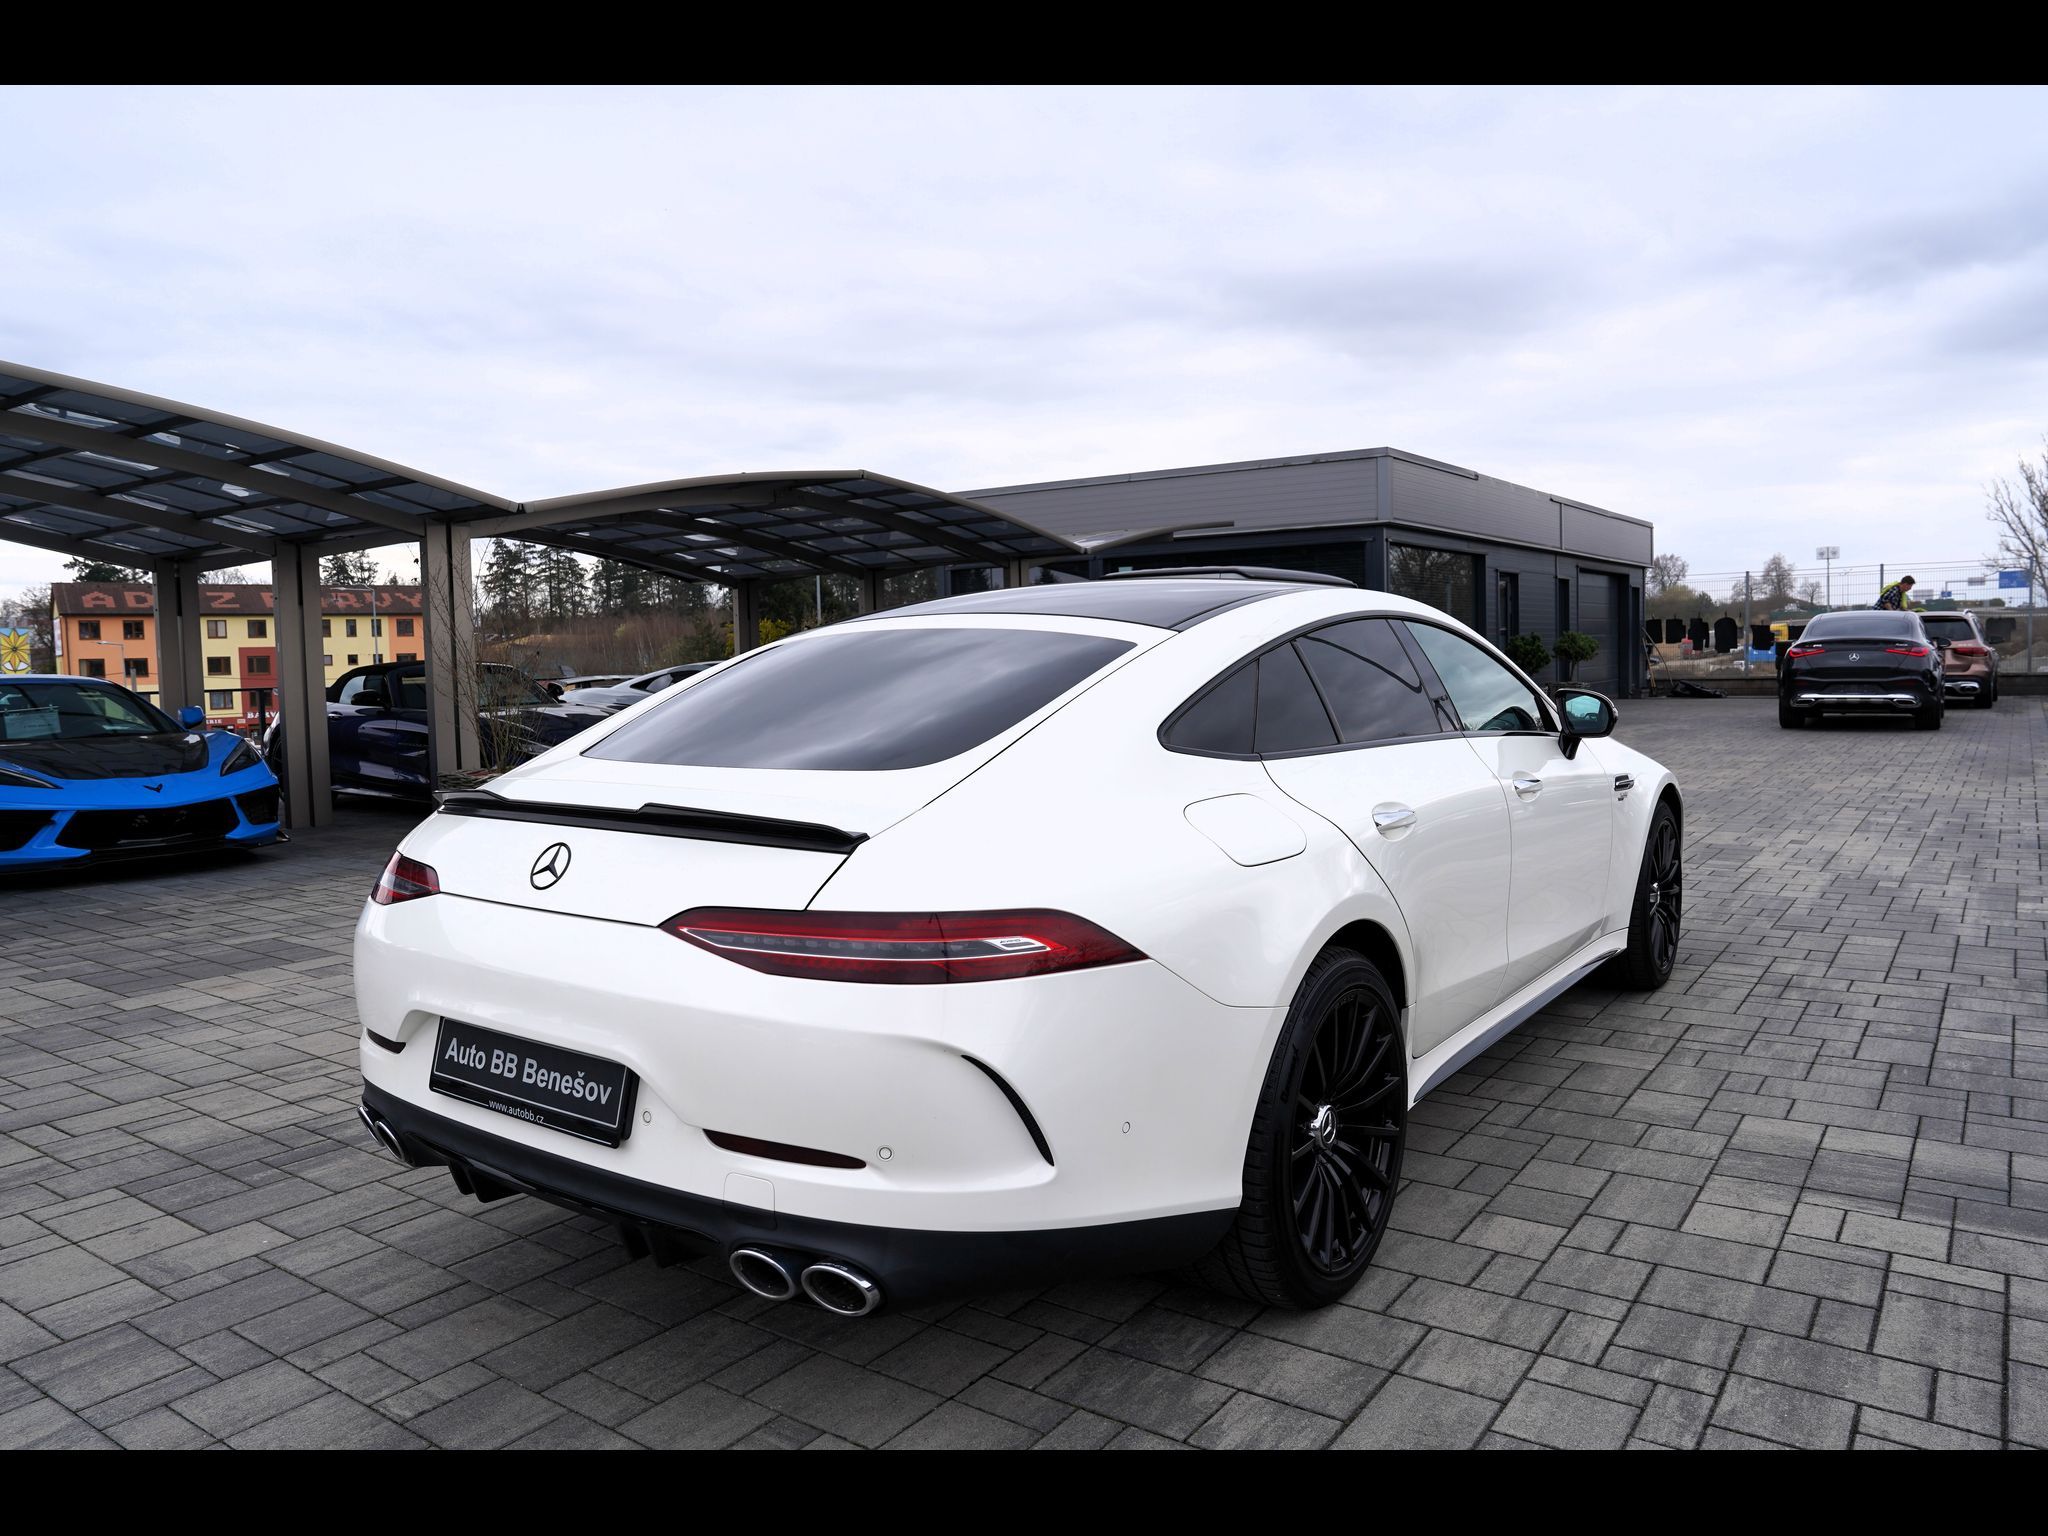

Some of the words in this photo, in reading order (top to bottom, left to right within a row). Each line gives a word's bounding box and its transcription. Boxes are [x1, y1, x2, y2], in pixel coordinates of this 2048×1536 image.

[444, 1037, 486, 1070] Auto
[490, 1048, 518, 1079] BB
[522, 1057, 613, 1105] Benešov
[488, 1099, 545, 1125] www.autobb.cz
